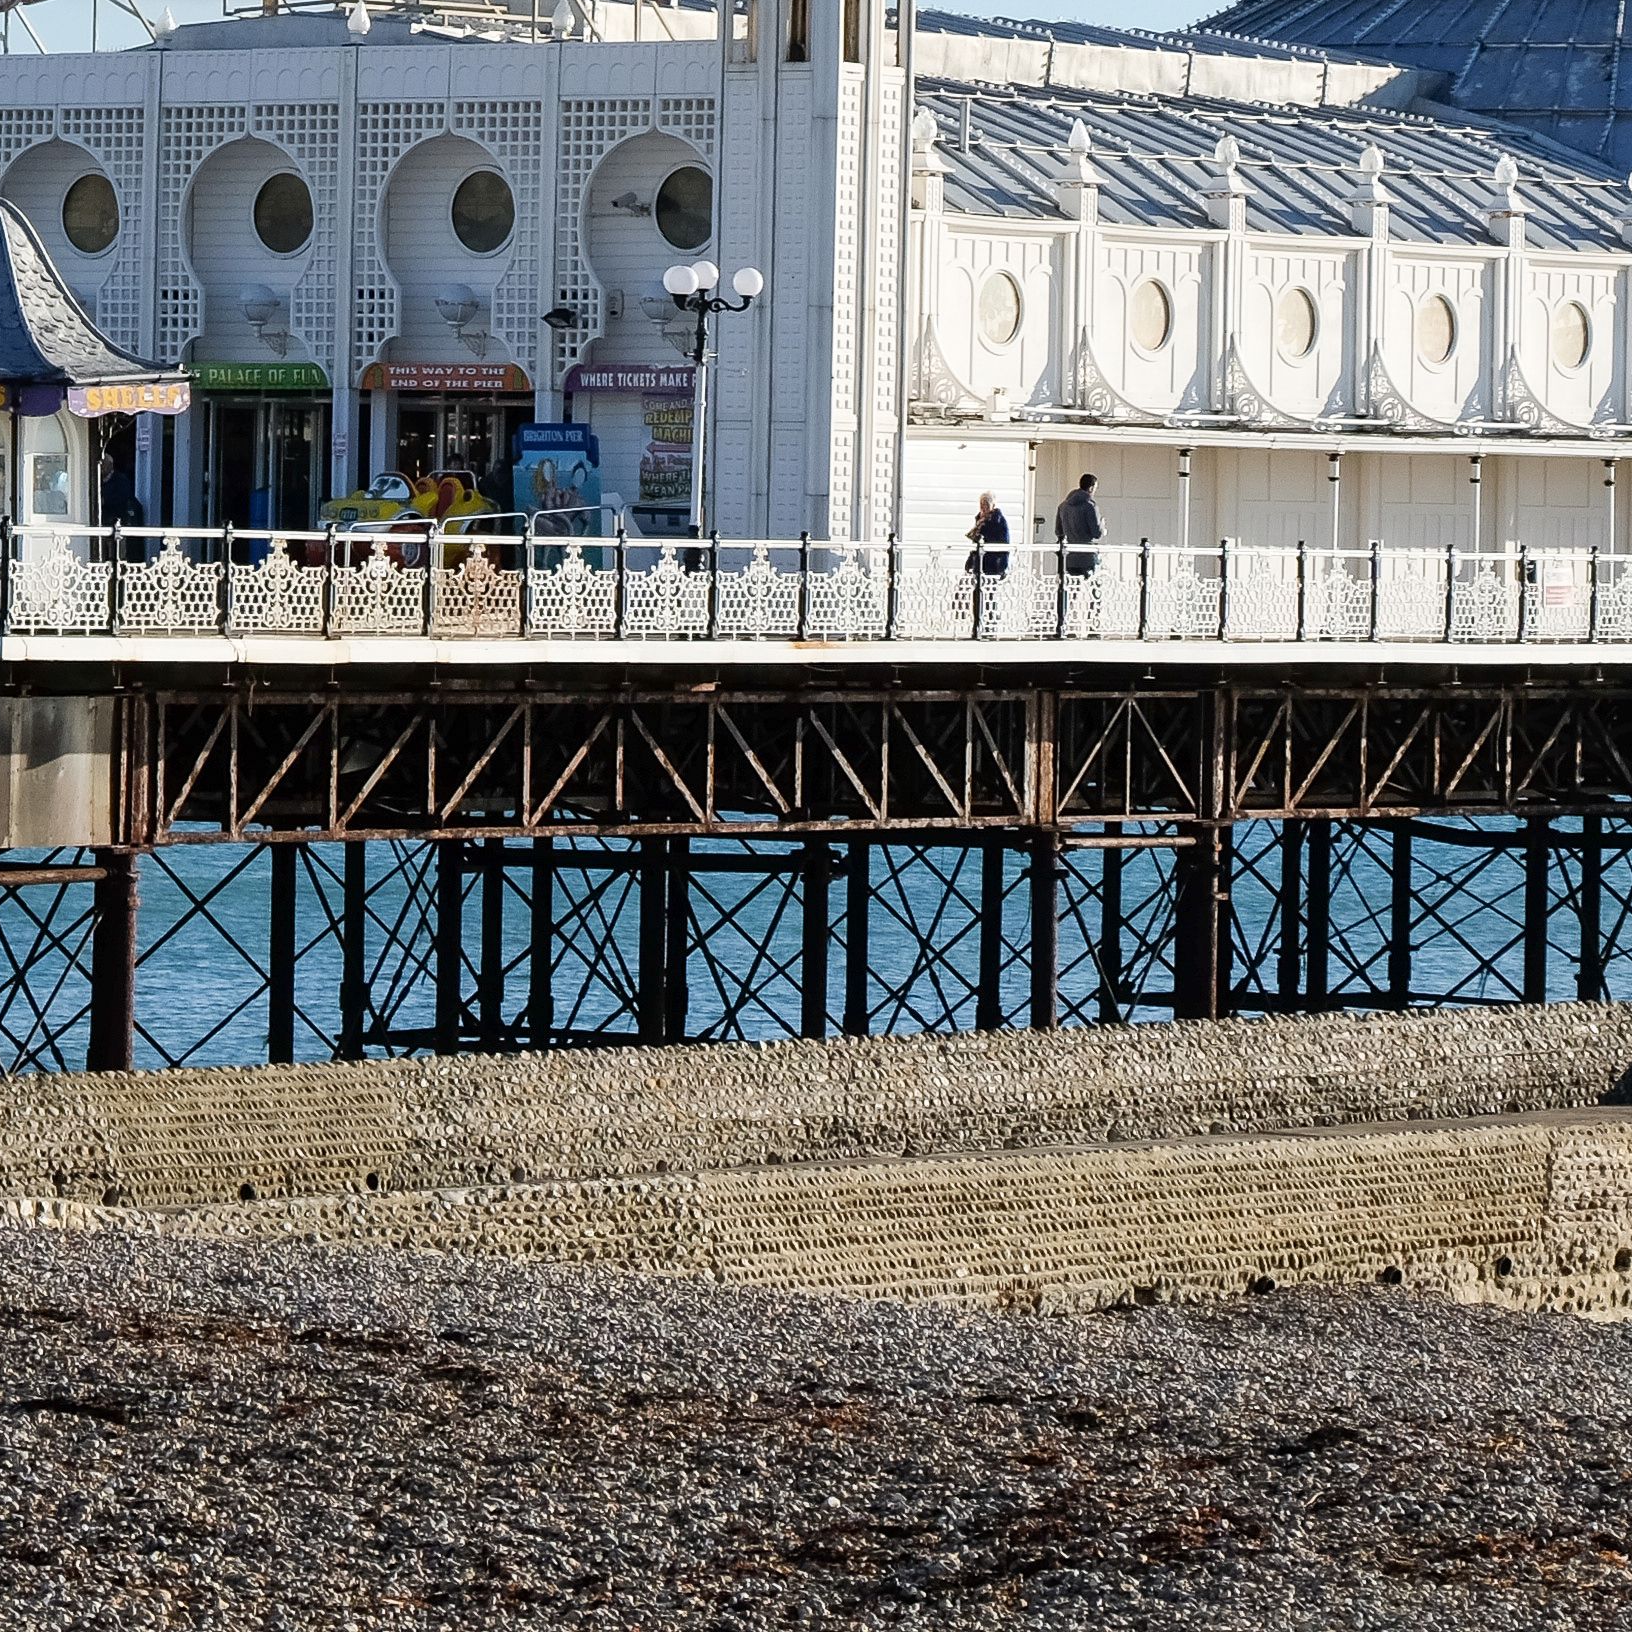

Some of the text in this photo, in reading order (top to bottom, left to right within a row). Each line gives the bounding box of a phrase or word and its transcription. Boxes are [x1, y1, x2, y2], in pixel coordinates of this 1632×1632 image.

[209, 369, 261, 384] PALACE
[269, 369, 286, 383] OF
[389, 367, 505, 375] THIS WAY TO THE
[474, 380, 503, 388] PIER
[580, 372, 614, 387] WHERE
[618, 372, 656, 387] TICKETS
[660, 372, 688, 387] MAKE
[86, 384, 180, 410] SHELLS
